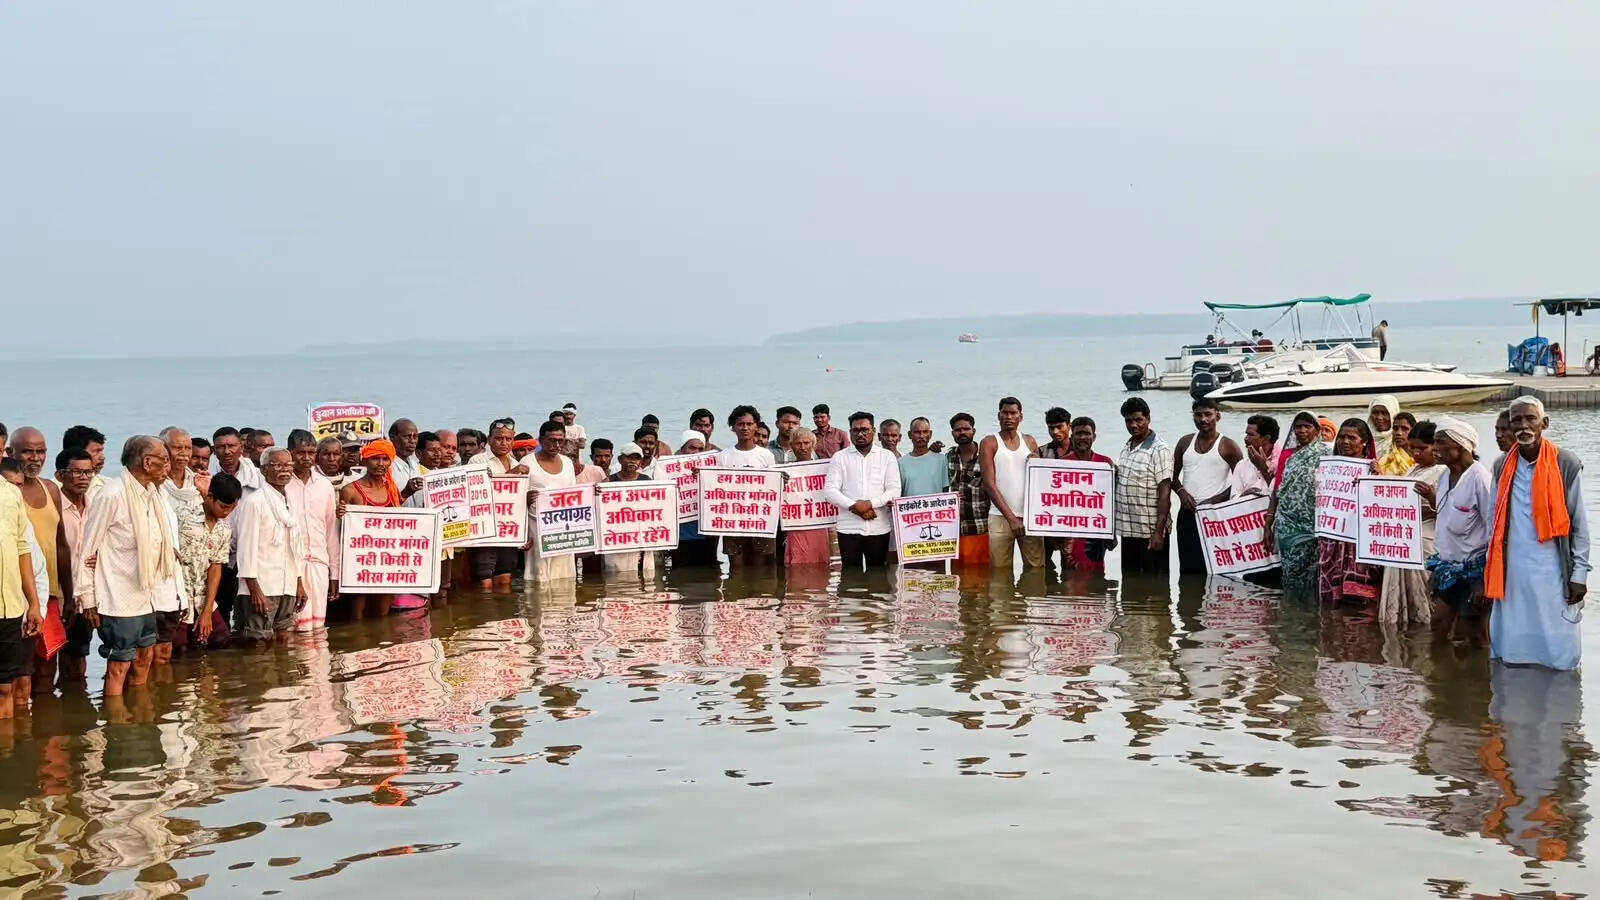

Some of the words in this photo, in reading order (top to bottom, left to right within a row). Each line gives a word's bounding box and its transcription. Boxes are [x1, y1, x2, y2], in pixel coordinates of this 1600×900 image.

[318, 420, 357, 434] न्याय
[359, 417, 374, 433] दो
[492, 481, 519, 493] पना
[717, 473, 733, 484] हम
[735, 474, 766, 485] अपना
[804, 474, 827, 491] प्रशा
[1051, 471, 1094, 488] डुबान
[430, 489, 450, 505] पालन
[452, 484, 466, 498] करो
[549, 490, 583, 507] जल
[601, 491, 623, 503] हम
[626, 488, 666, 502] अपना
[704, 488, 746, 500] अधिकार
[748, 489, 777, 501] मांगते
[1040, 490, 1105, 509] प्रभावितों
[1373, 485, 1384, 497] हम
[1386, 486, 1407, 498] अपना
[731, 502, 759, 515] किसी
[762, 504, 772, 515] से
[781, 500, 801, 519] होश
[803, 499, 813, 518] में
[898, 500, 922, 512] हाईकोर्ट
[922, 499, 929, 508] के
[930, 498, 947, 507] आदेश
[1362, 503, 1393, 519] अधिकार
[1395, 505, 1416, 520] मांगते
[364, 518, 382, 529] हम
[384, 518, 417, 530] अपना
[540, 506, 591, 525] सत्याग्रह
[606, 507, 664, 524] अधिकार
[711, 517, 736, 530] भीख
[738, 518, 767, 530] मांगते
[902, 511, 932, 524] पालन
[934, 507, 955, 519] करो
[1034, 511, 1053, 526] को
[1056, 515, 1089, 528] न्याय
[1092, 513, 1107, 528] दो
[1202, 516, 1228, 538] जिला
[1227, 509, 1266, 535] प्रशास
[497, 521, 519, 537] हेंगे
[604, 529, 639, 546] लेकर
[641, 525, 671, 543] रहेंगे
[1383, 522, 1402, 538] किसी
[1405, 524, 1413, 539] से
[350, 534, 396, 549] अधिकार
[399, 535, 430, 550] मांगते
[1370, 540, 1385, 556] भीख
[1386, 542, 1410, 558] मांगते
[380, 552, 410, 566] किसी
[413, 552, 423, 566] से
[1232, 541, 1246, 562] में
[356, 569, 384, 584] भीख
[386, 569, 418, 584] मांगते
